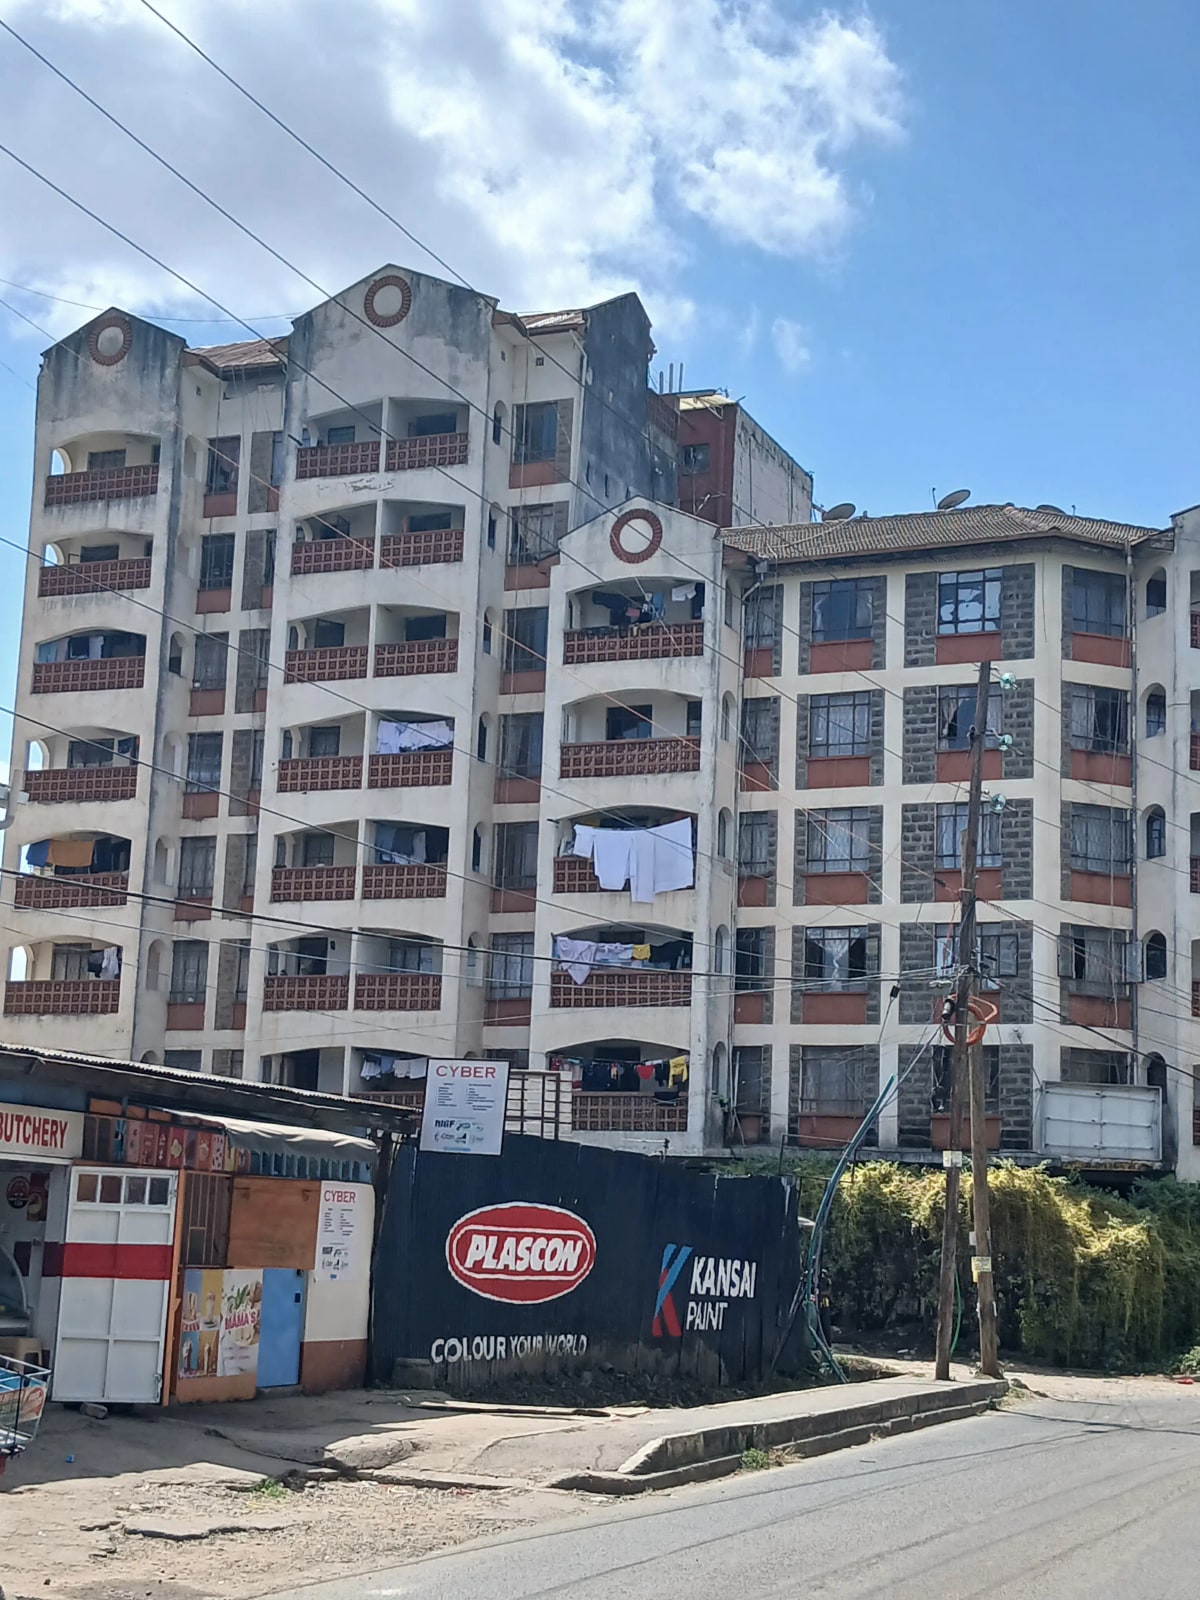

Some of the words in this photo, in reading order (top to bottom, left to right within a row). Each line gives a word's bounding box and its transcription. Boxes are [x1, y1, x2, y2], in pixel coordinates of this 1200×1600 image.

[436, 1065, 497, 1079] CYBER
[324, 1190, 356, 1203] CYBER
[464, 1234, 583, 1272] PLASCON
[690, 1256, 757, 1298] KANSAI
[225, 1311, 257, 1330] MAMA'S
[686, 1301, 728, 1331] PAINT
[431, 1336, 507, 1364] COLOUR
[510, 1335, 543, 1359] YOUR
[544, 1333, 588, 1358] WORLD
